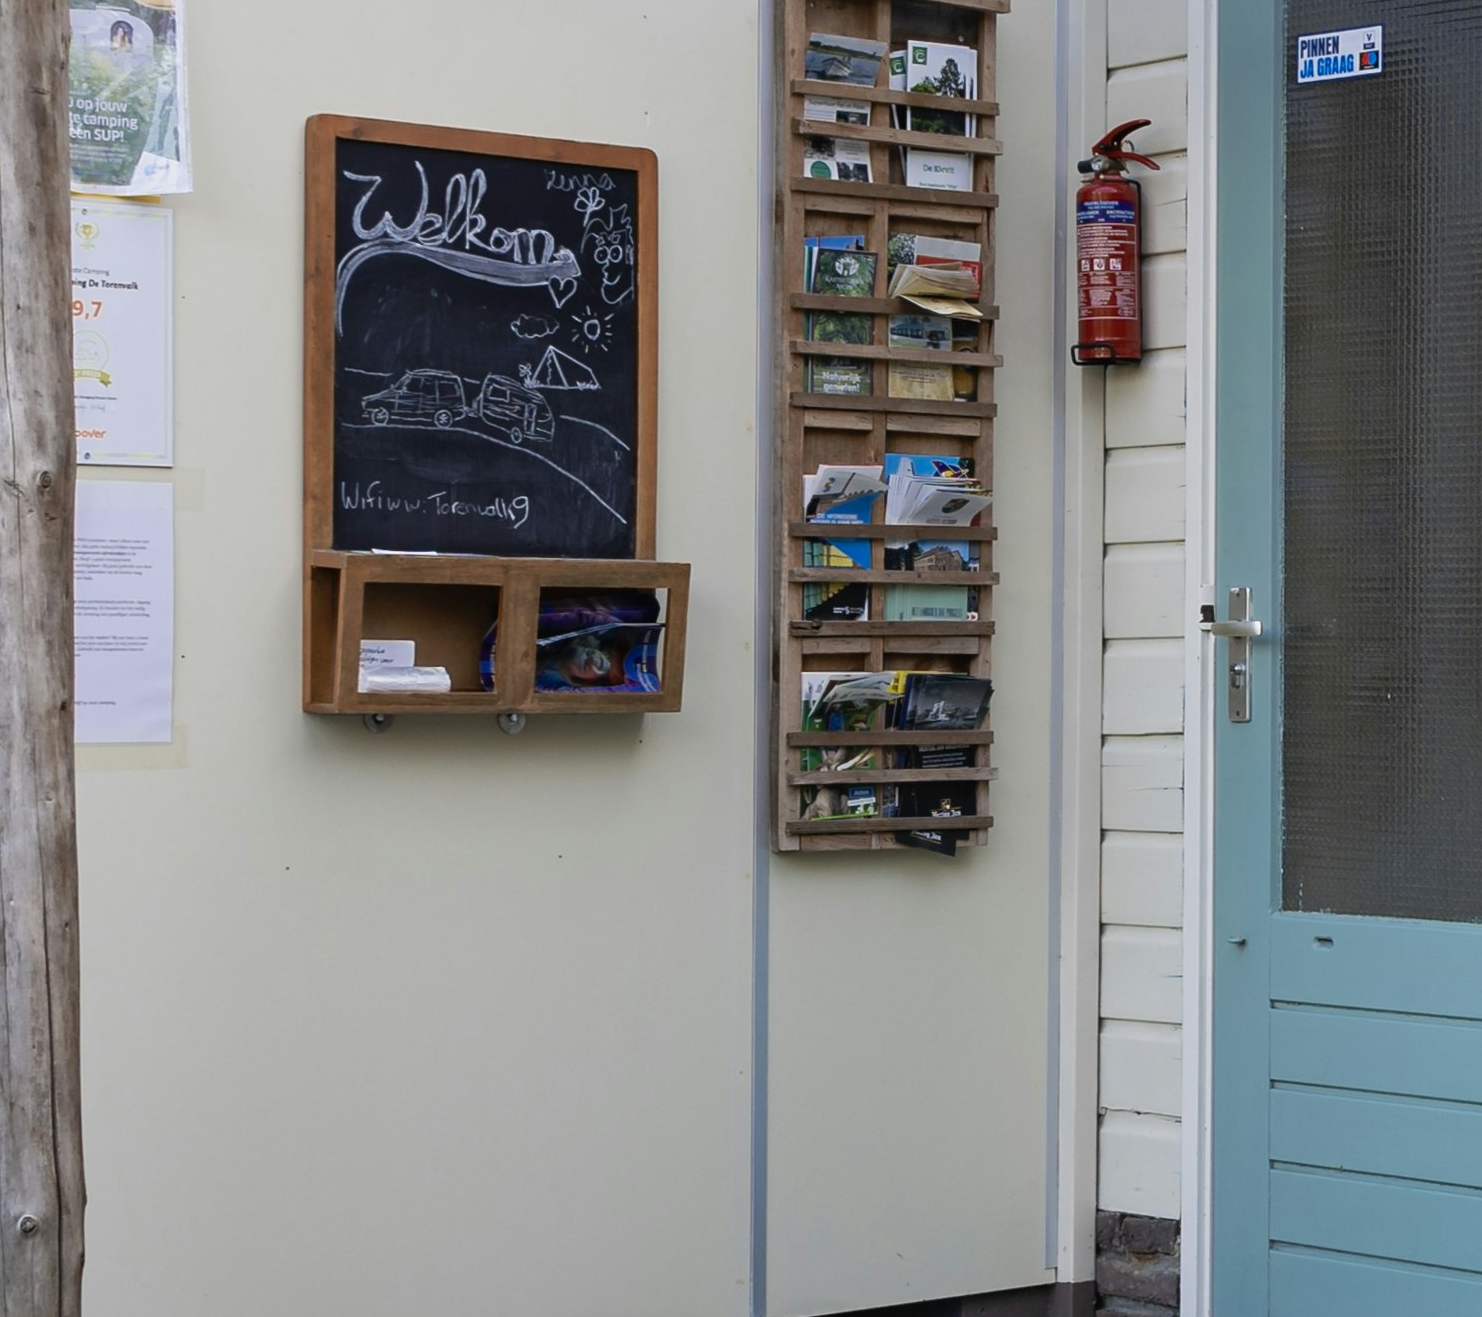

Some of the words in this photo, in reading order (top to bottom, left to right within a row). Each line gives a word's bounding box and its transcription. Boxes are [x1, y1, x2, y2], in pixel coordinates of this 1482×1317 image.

[1300, 35, 1340, 58] PINNEN
[1300, 59, 1314, 78] JA
[1317, 53, 1354, 77] GRAAG
[76, 99, 94, 112] op
[95, 98, 128, 113] jouw
[83, 114, 138, 130] camping
[94, 129, 125, 142] SUP!
[342, 160, 556, 265] Welkom
[88, 279, 99, 288] De
[72, 300, 103, 320] 9,7
[74, 429, 107, 439] oover
